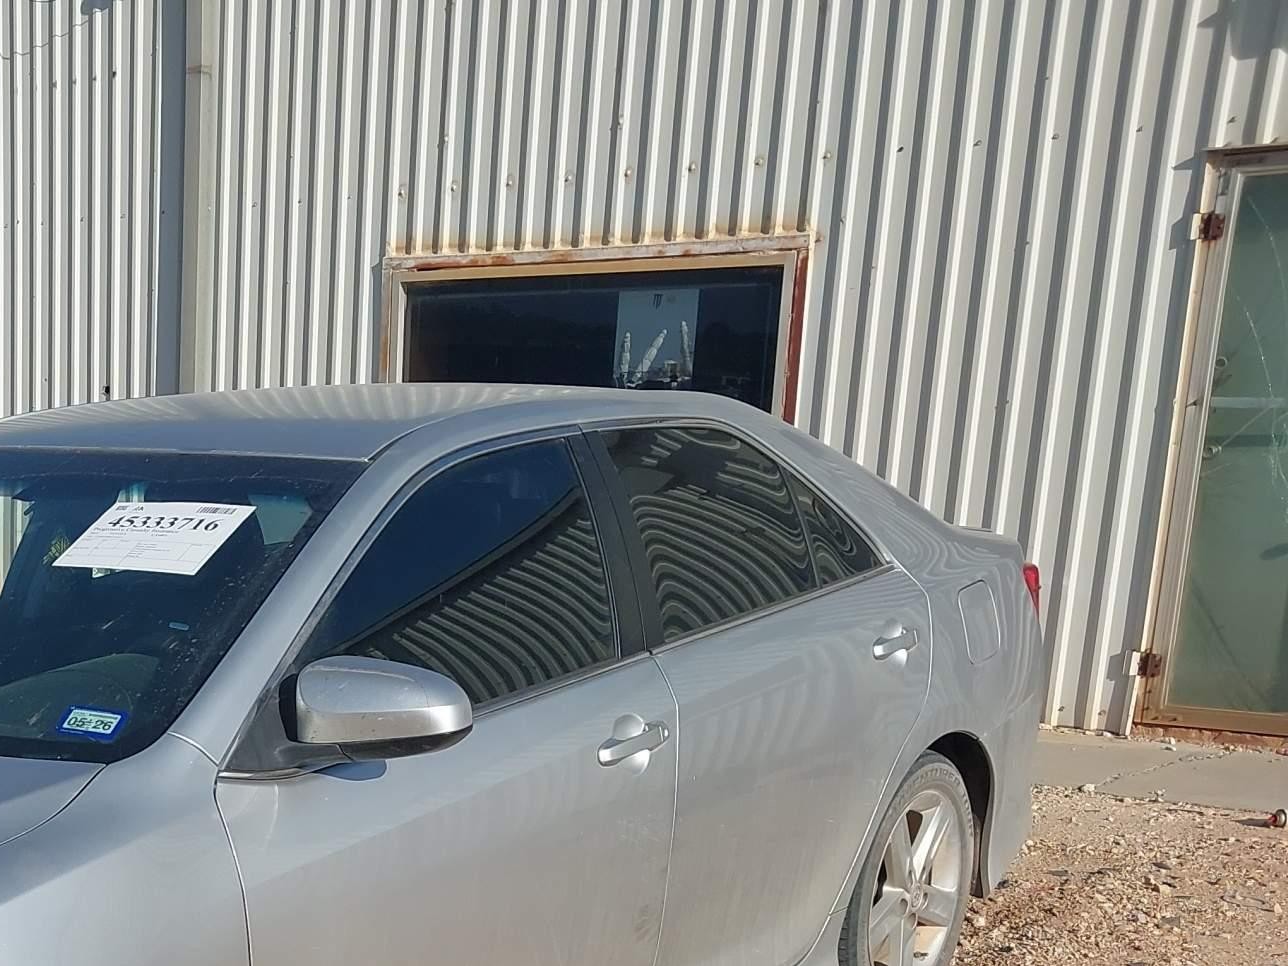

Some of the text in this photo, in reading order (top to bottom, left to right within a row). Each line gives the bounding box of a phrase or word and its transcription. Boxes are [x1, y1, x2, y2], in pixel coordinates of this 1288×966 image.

[108, 513, 223, 533] 45333716
[67, 716, 114, 731] 05 26
